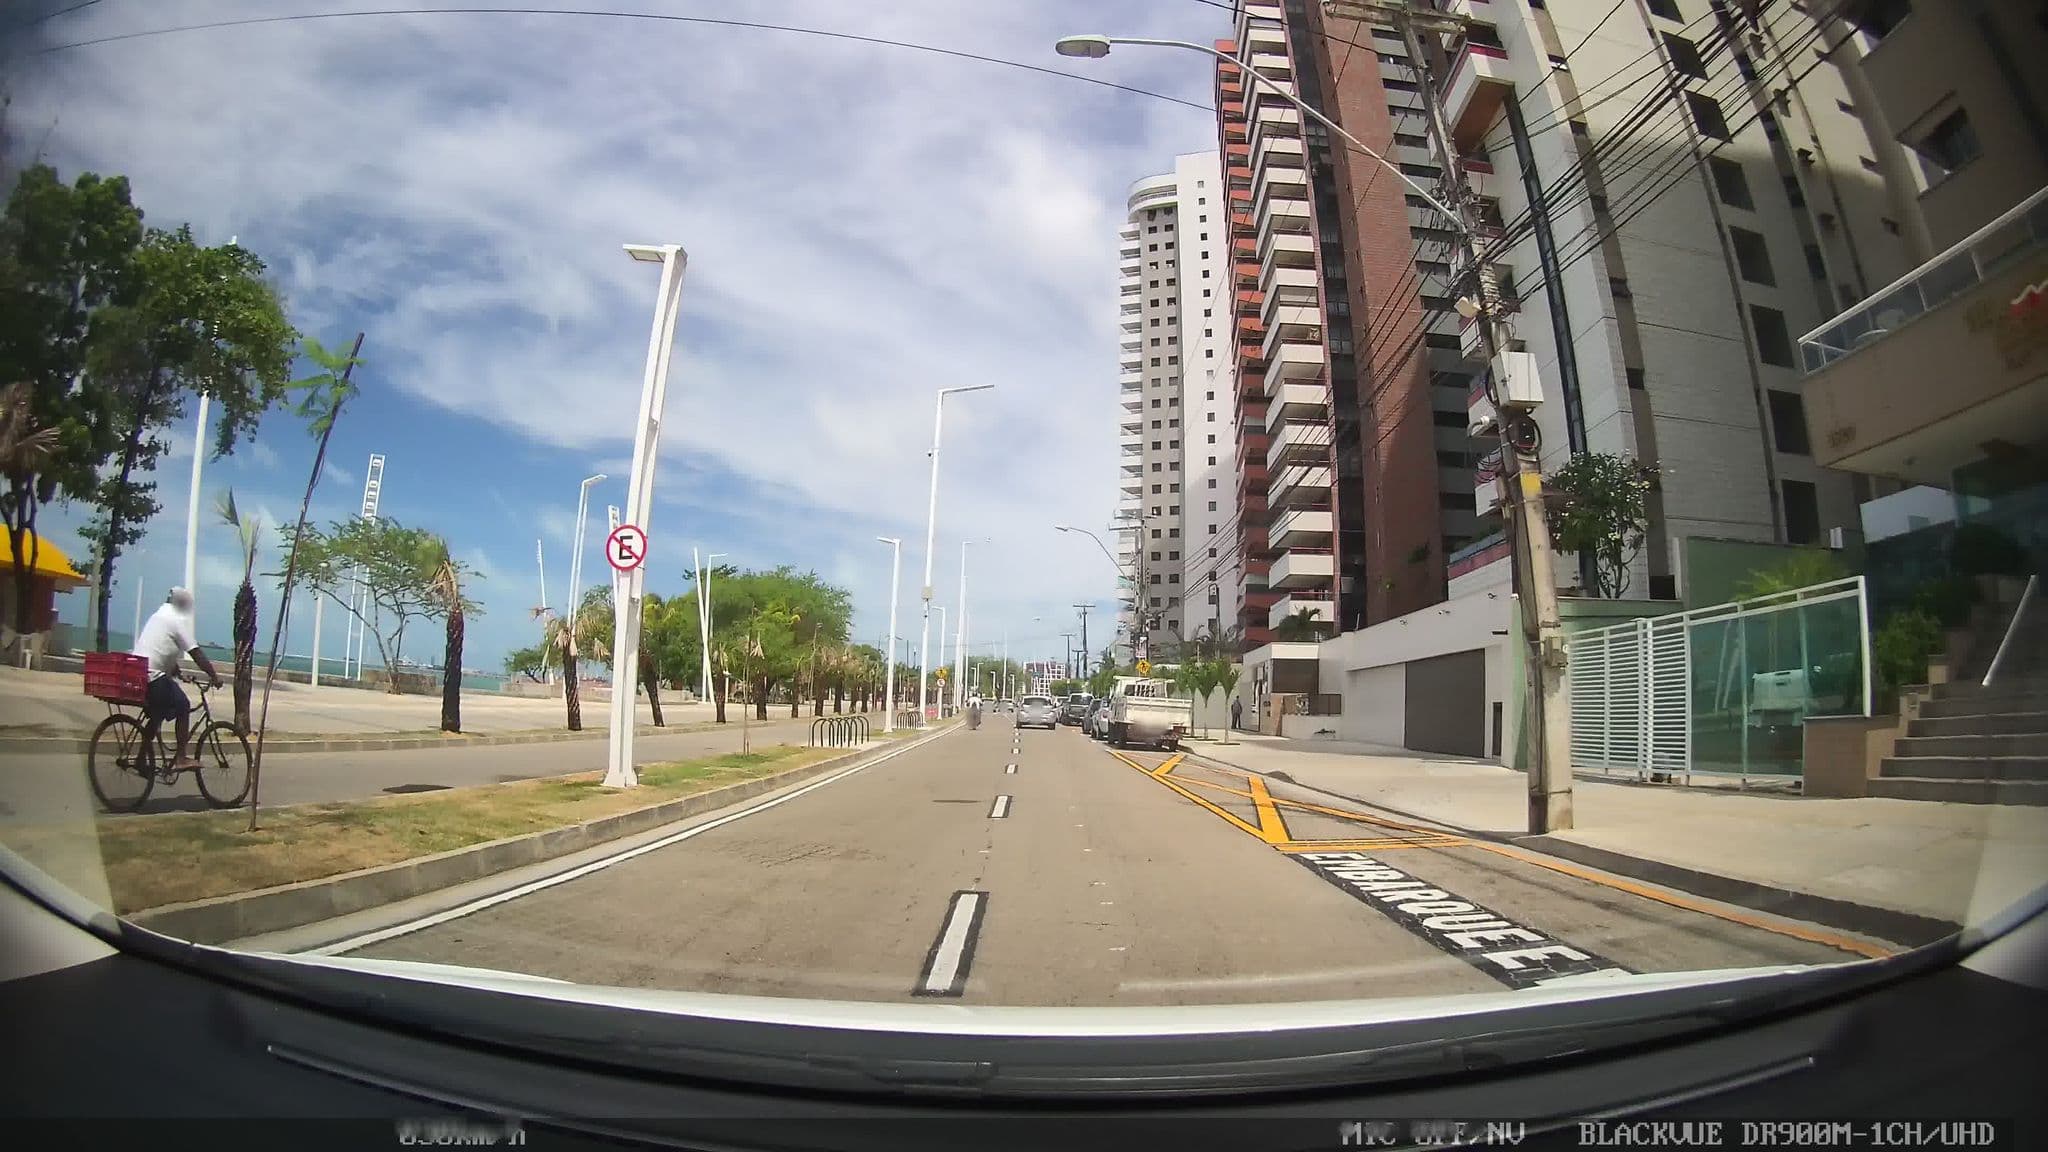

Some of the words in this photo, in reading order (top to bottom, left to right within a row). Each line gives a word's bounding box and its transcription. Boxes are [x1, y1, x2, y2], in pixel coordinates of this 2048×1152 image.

[619, 535, 633, 560] E
[1299, 853, 1547, 949] EMBARQUE
[1480, 944, 1592, 970] E
